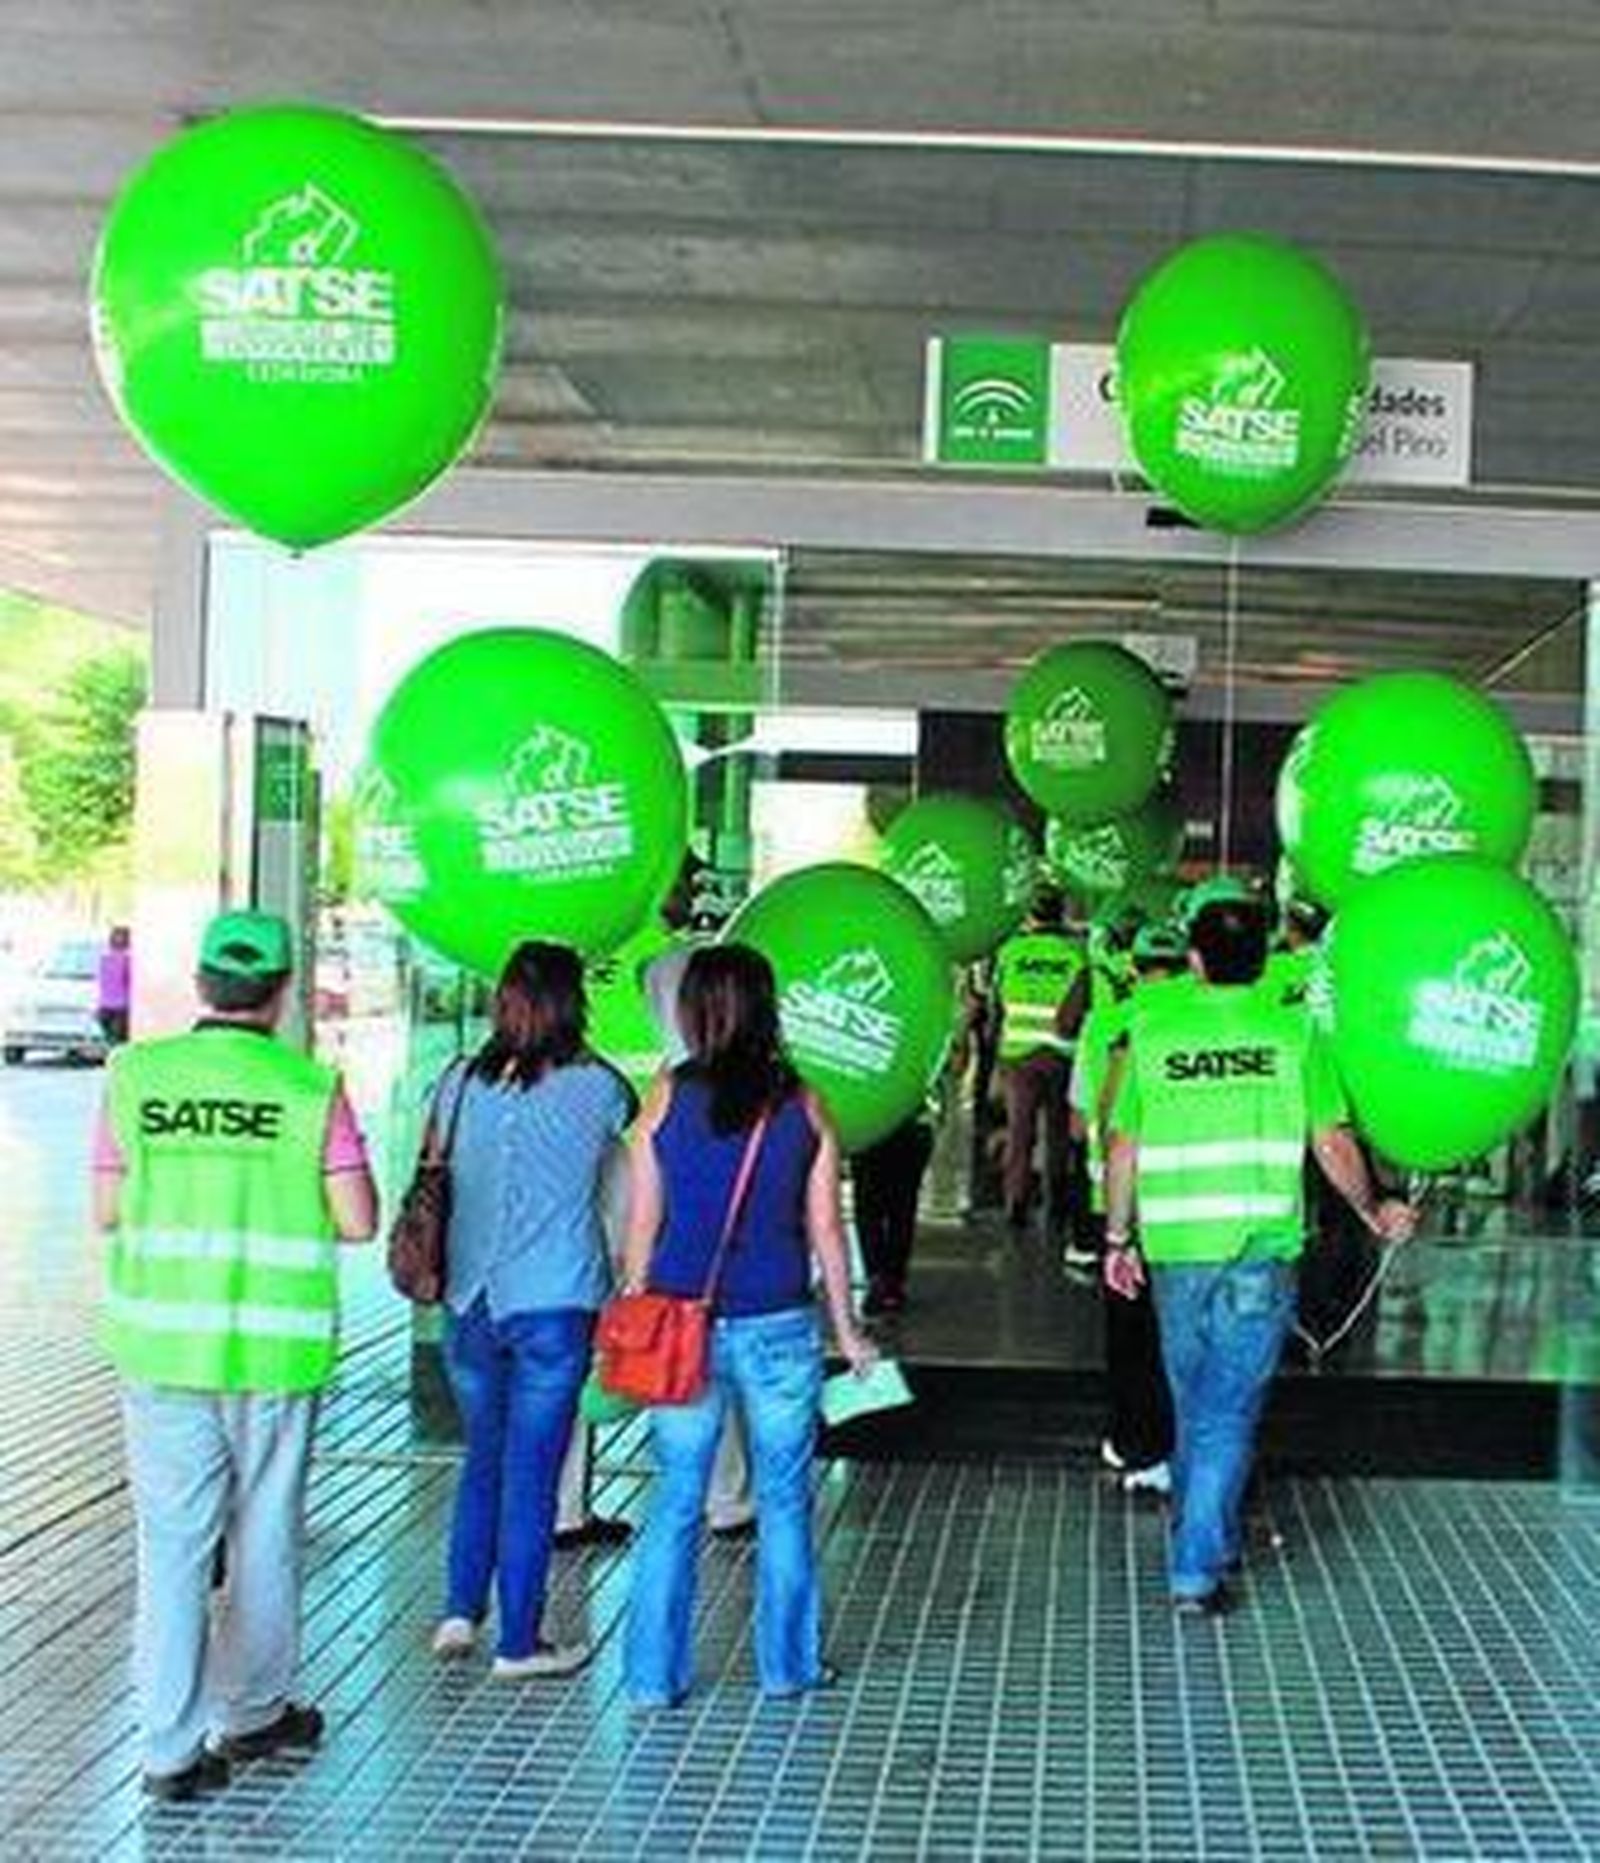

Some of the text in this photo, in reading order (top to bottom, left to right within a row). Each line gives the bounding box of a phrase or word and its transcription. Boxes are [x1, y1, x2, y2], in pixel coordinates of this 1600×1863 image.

[194, 267, 392, 320] SATSE
[1180, 398, 1299, 442] SATSE
[476, 782, 624, 840] SATSE
[779, 980, 902, 1049] SATSE
[1165, 1046, 1277, 1080] SATSE
[140, 1098, 283, 1139] SATSE
